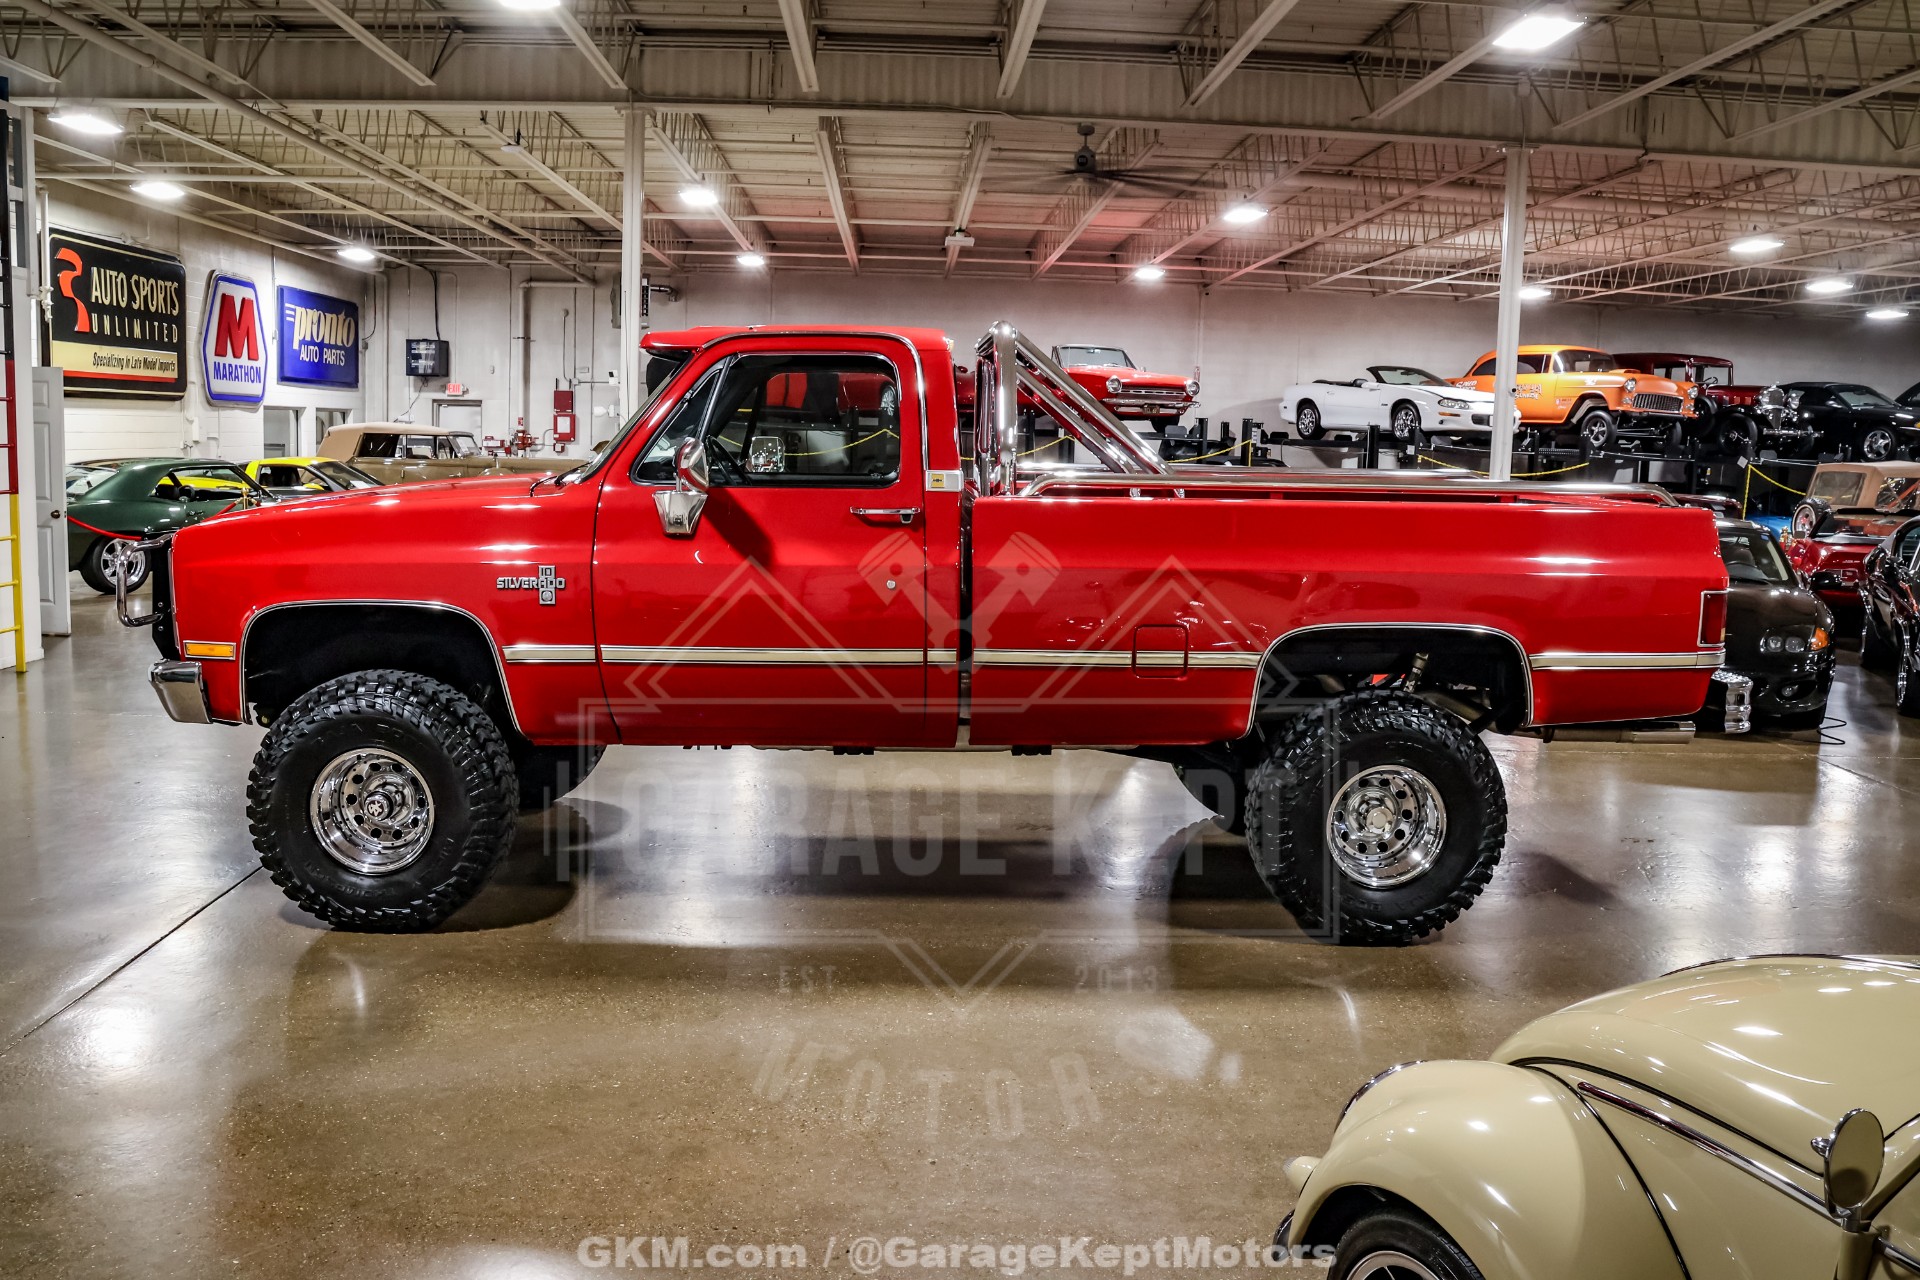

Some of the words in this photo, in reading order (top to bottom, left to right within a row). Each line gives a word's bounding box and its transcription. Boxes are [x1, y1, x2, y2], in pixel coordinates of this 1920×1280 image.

[91, 267, 128, 308] AUTO
[130, 274, 179, 316] SPORTS
[91, 313, 178, 343] UNLIMITED
[214, 293, 259, 361] M
[292, 307, 356, 350] pronto
[93, 352, 124, 370] Specializing
[131, 356, 142, 369] Late
[143, 357, 158, 371] Model
[300, 344, 319, 363] AUTO
[323, 348, 346, 367] PARTS
[214, 361, 261, 383] MARATHON
[448, 384, 460, 393] EXIT
[496, 576, 566, 589] SILVERADO
